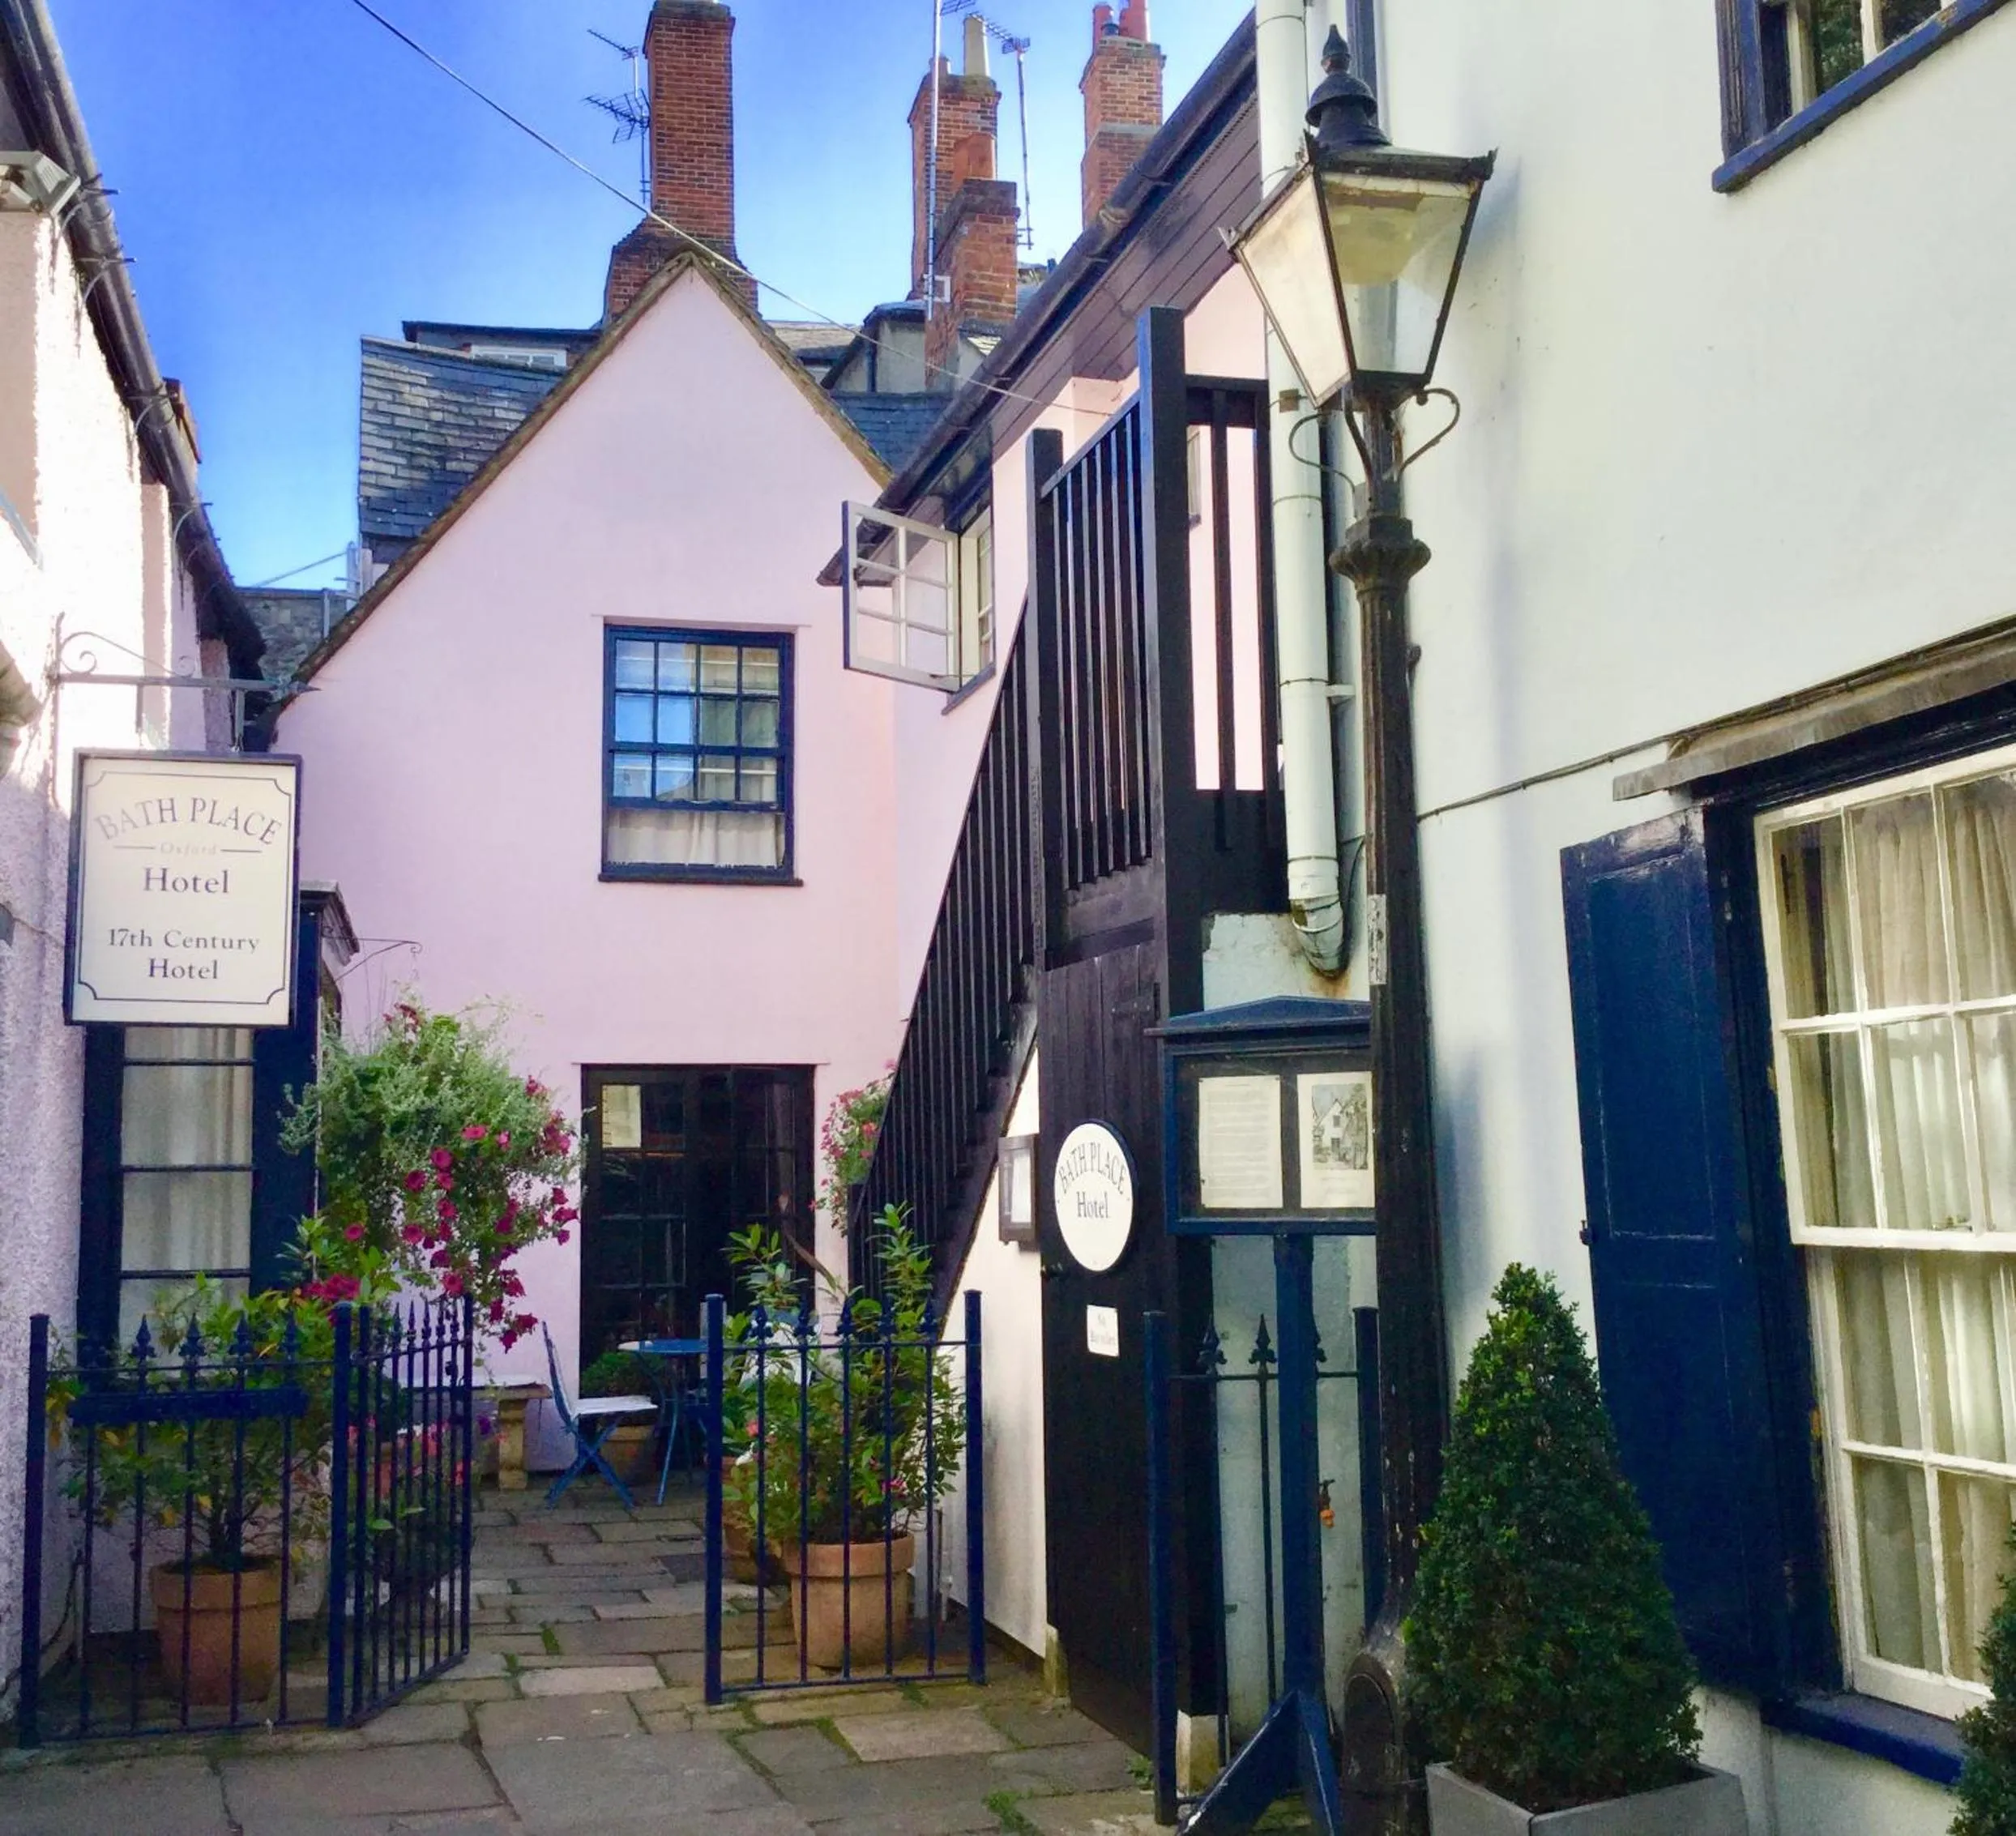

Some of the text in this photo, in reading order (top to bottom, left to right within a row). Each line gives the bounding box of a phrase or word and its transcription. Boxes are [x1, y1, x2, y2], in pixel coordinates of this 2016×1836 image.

[95, 797, 282, 845] BATH PLACE
[143, 867, 229, 894] Hotel
[109, 929, 260, 954] 17th Century
[147, 958, 219, 980] Hotel
[1058, 1142, 1126, 1195] BATH PLACE
[1076, 1191, 1108, 1219] Hotel
